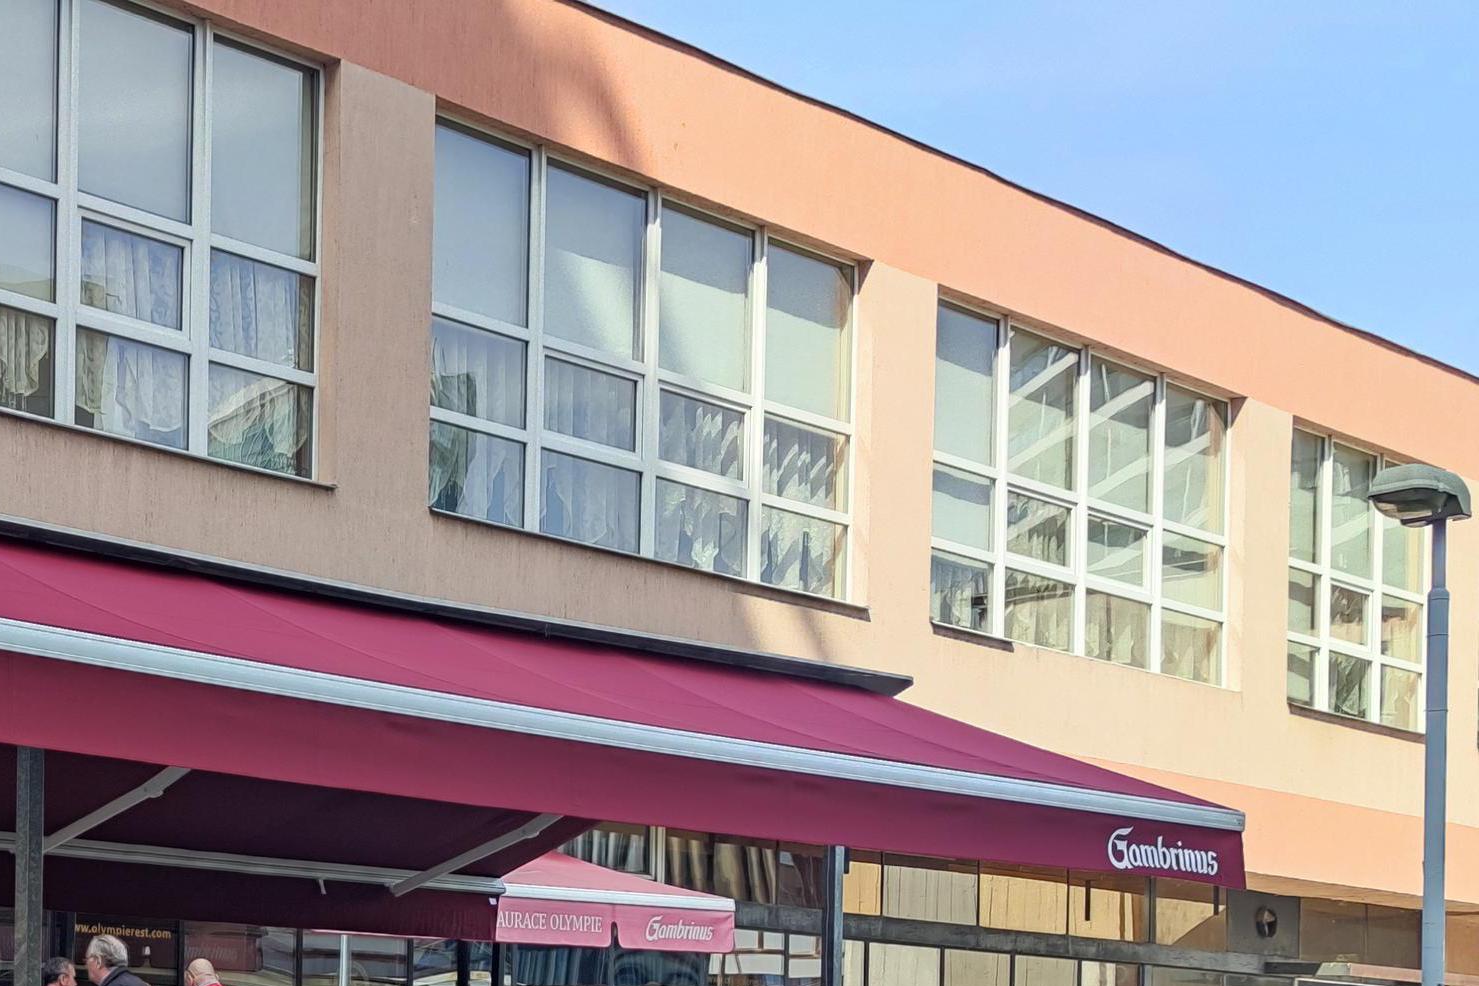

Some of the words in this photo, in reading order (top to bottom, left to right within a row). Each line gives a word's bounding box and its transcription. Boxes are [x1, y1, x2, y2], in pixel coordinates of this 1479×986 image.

[1107, 825, 1218, 876] Gambrinus
[549, 914, 603, 933] OLYMPIE
[645, 915, 714, 942] Gambrinus
